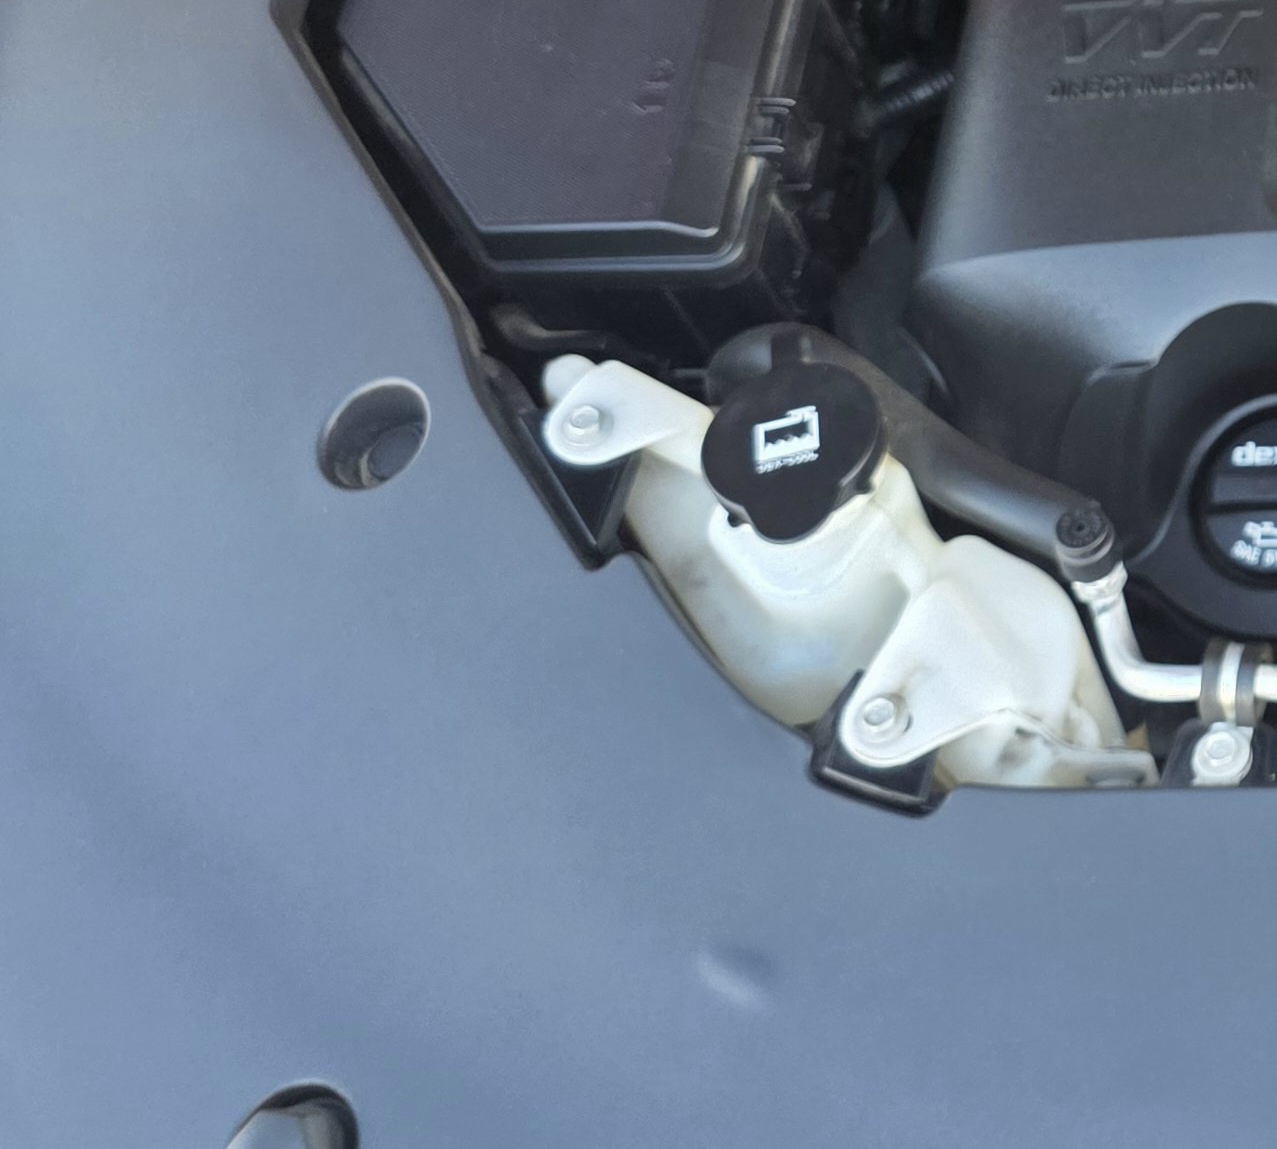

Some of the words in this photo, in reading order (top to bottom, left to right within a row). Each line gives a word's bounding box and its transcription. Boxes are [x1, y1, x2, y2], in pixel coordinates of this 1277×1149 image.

[1062, 7, 1265, 65] VVT
[1046, 74, 1132, 103] DIRECT
[1134, 67, 1259, 99] INJECTION
[1231, 539, 1260, 566] SAE
